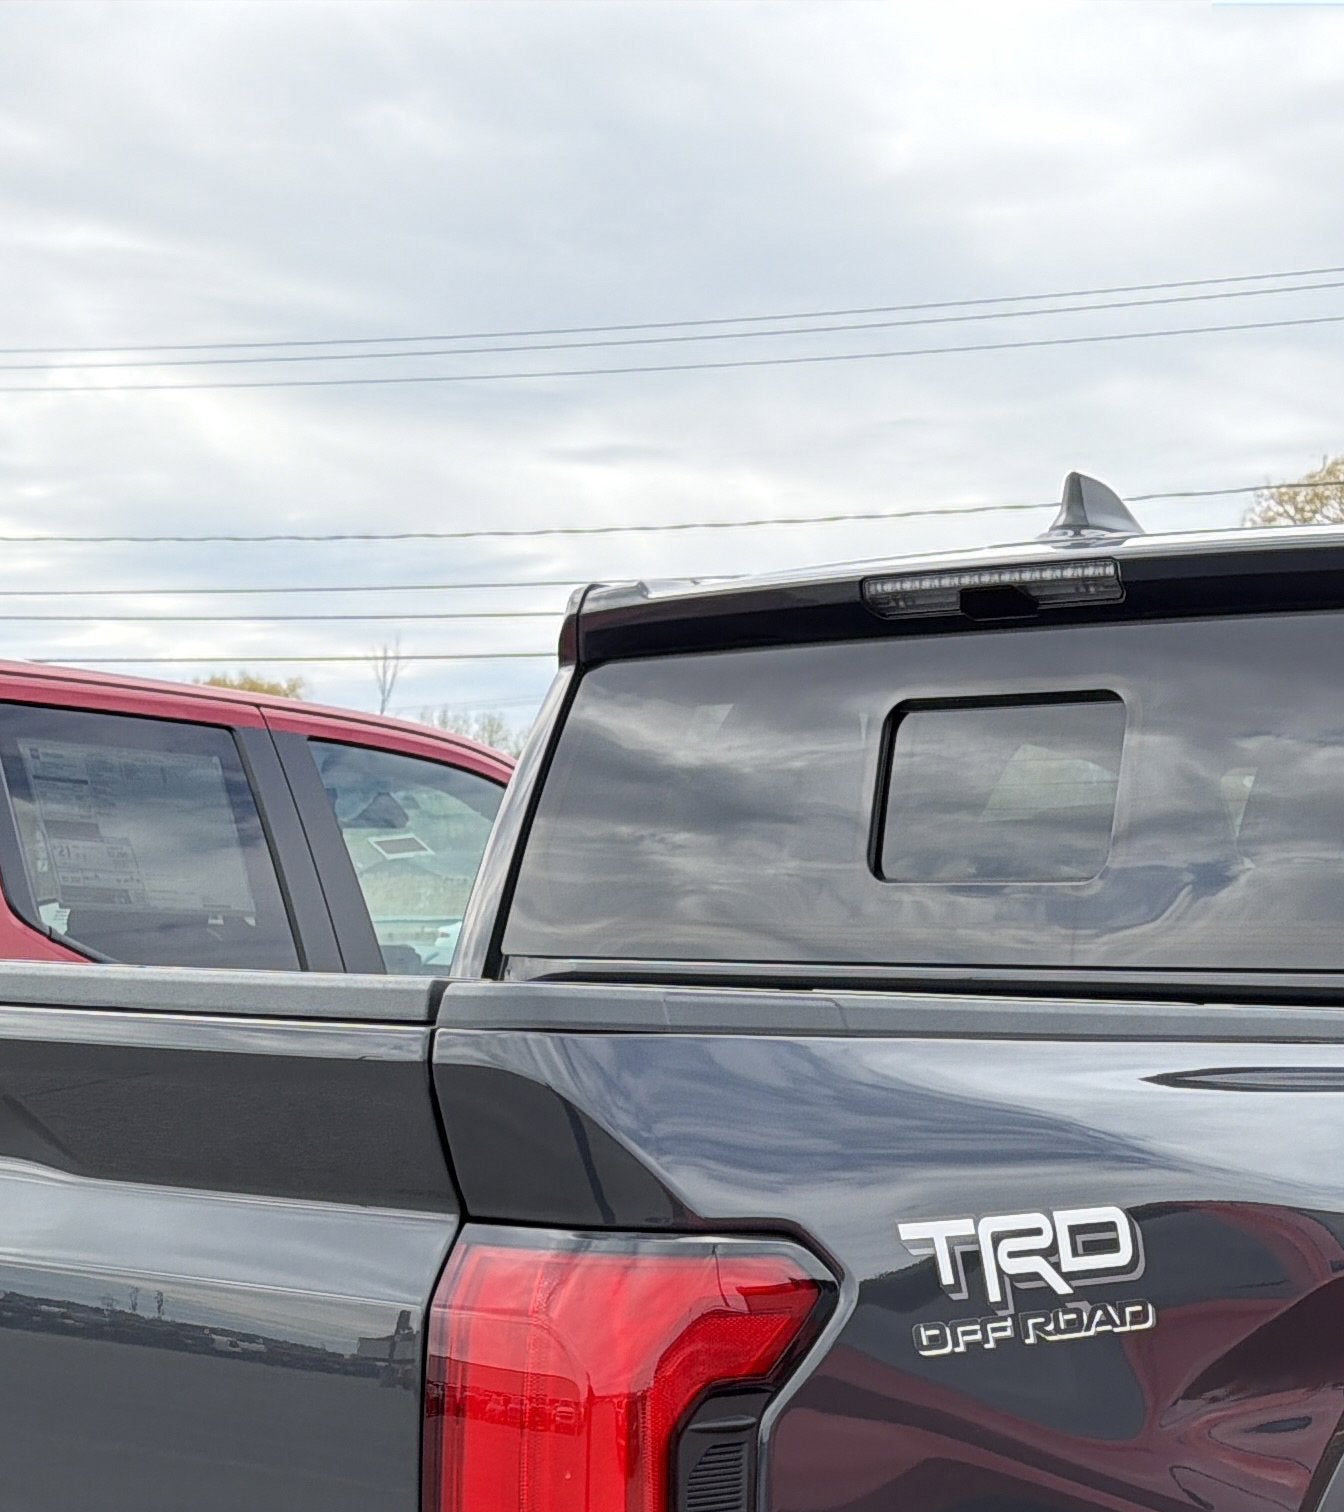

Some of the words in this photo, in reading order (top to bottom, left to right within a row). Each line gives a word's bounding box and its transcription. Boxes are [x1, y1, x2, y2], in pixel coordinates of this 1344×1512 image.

[896, 1205, 1145, 1312] TRD
[911, 1317, 1014, 1357] OFF
[1019, 1300, 1156, 1345] ROAD
